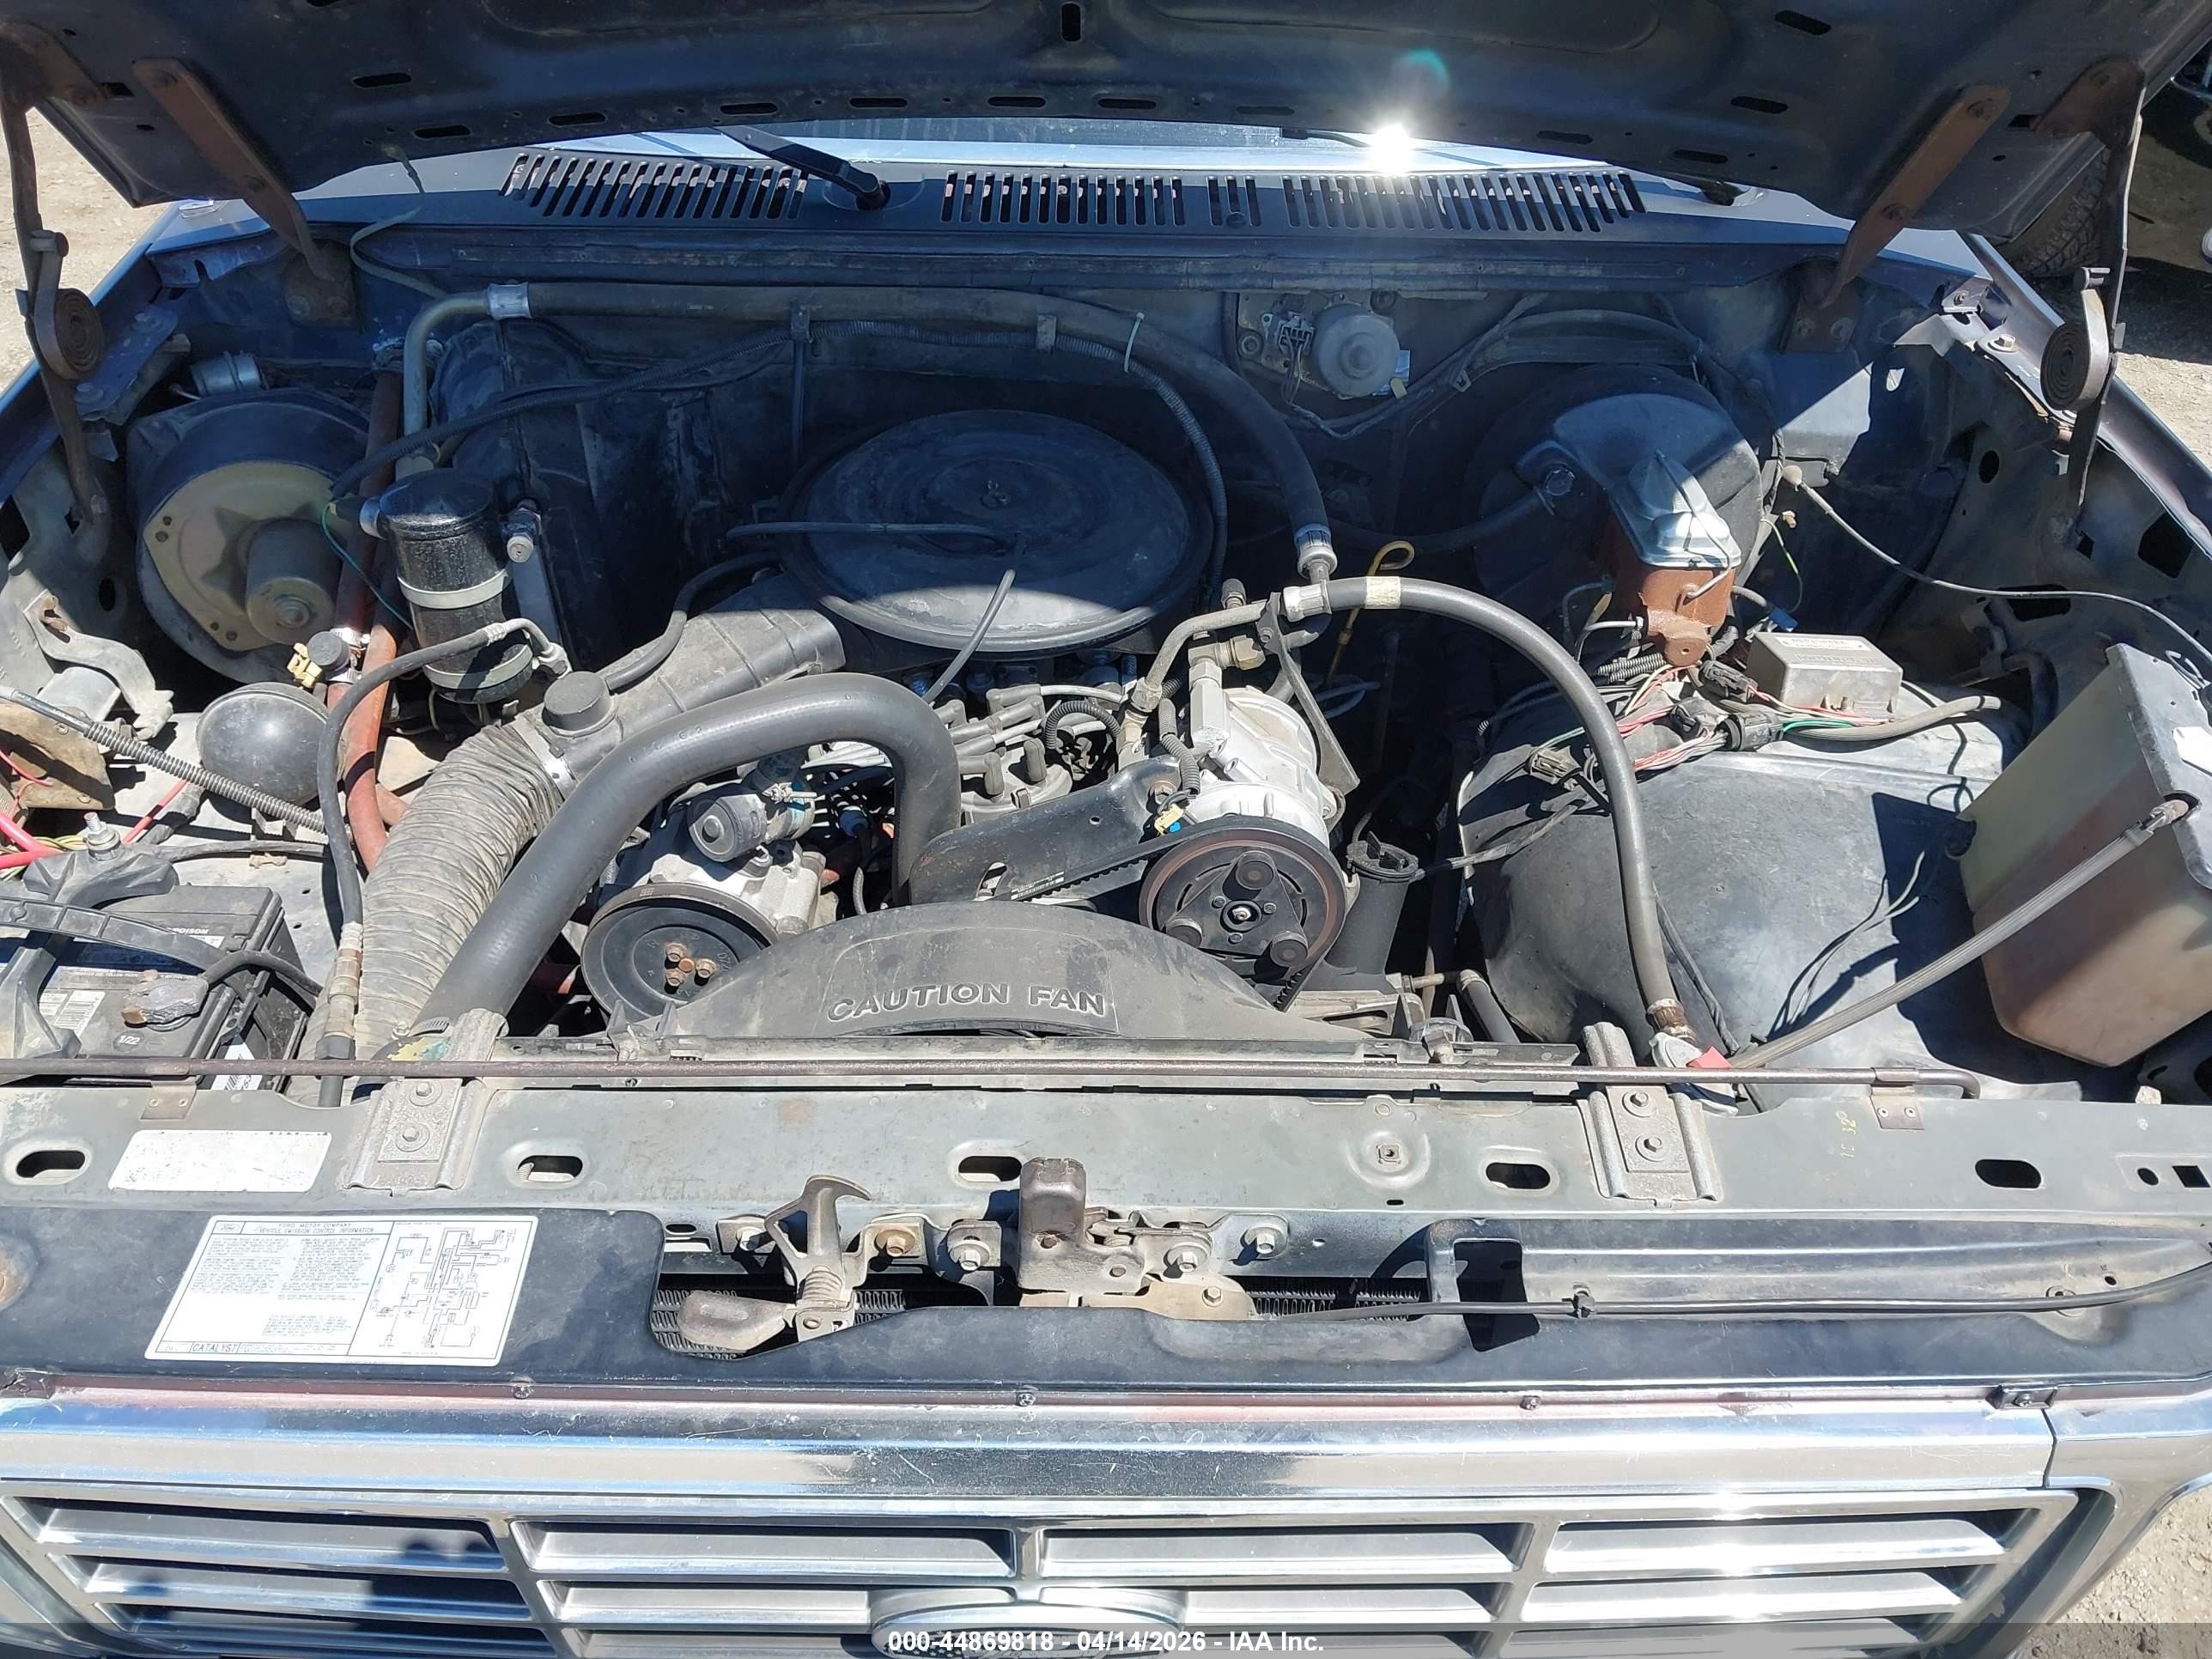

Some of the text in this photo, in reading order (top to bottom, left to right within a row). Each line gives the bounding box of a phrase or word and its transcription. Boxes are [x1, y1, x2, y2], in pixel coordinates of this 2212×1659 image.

[828, 981, 1106, 1022] CAUTION FAN
[118, 1035, 141, 1045] 1/22
[192, 1343, 238, 1353] CATALYST
